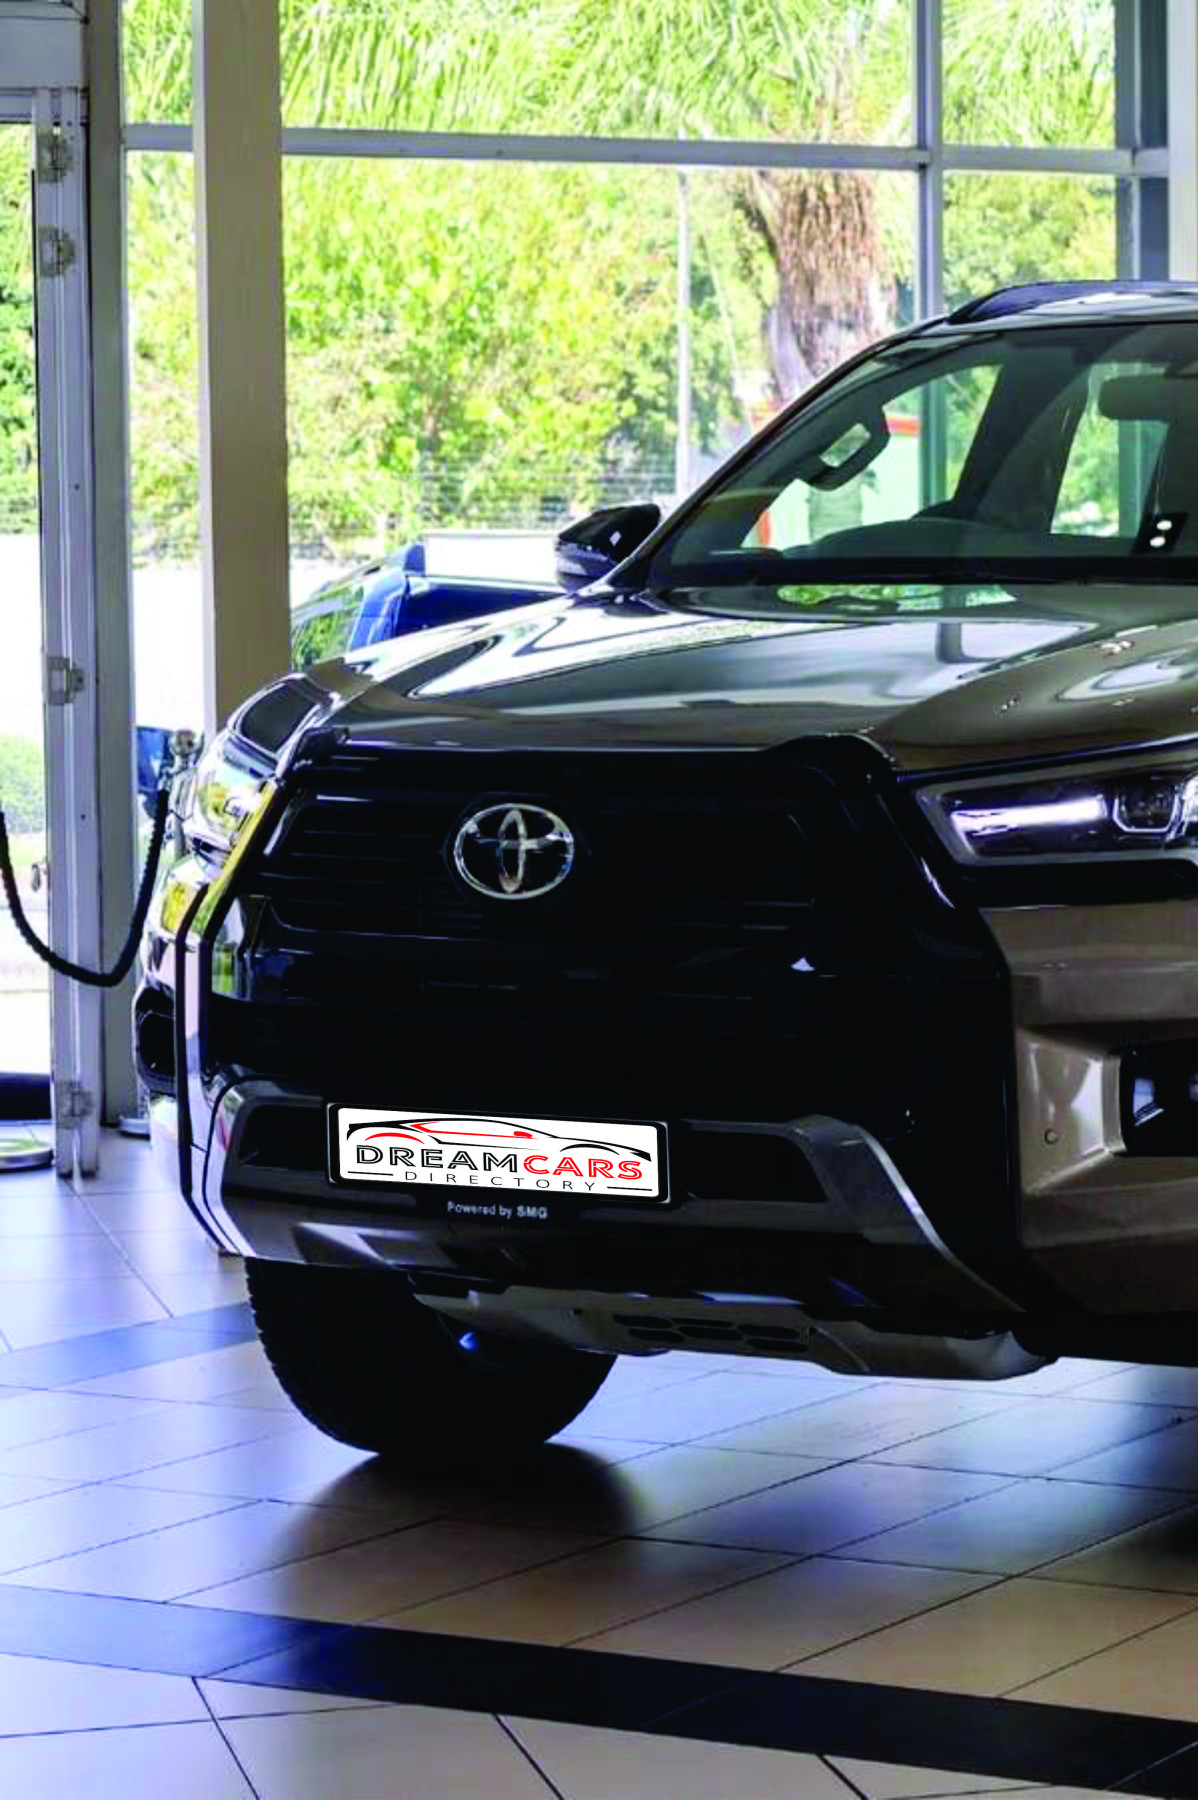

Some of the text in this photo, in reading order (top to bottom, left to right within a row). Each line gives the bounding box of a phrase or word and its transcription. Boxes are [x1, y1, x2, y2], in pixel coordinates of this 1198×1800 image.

[356, 1144, 643, 1180] DREAMCARS
[405, 1171, 596, 1191] DIRECTORY
[447, 1201, 548, 1219] Powered by SMG
